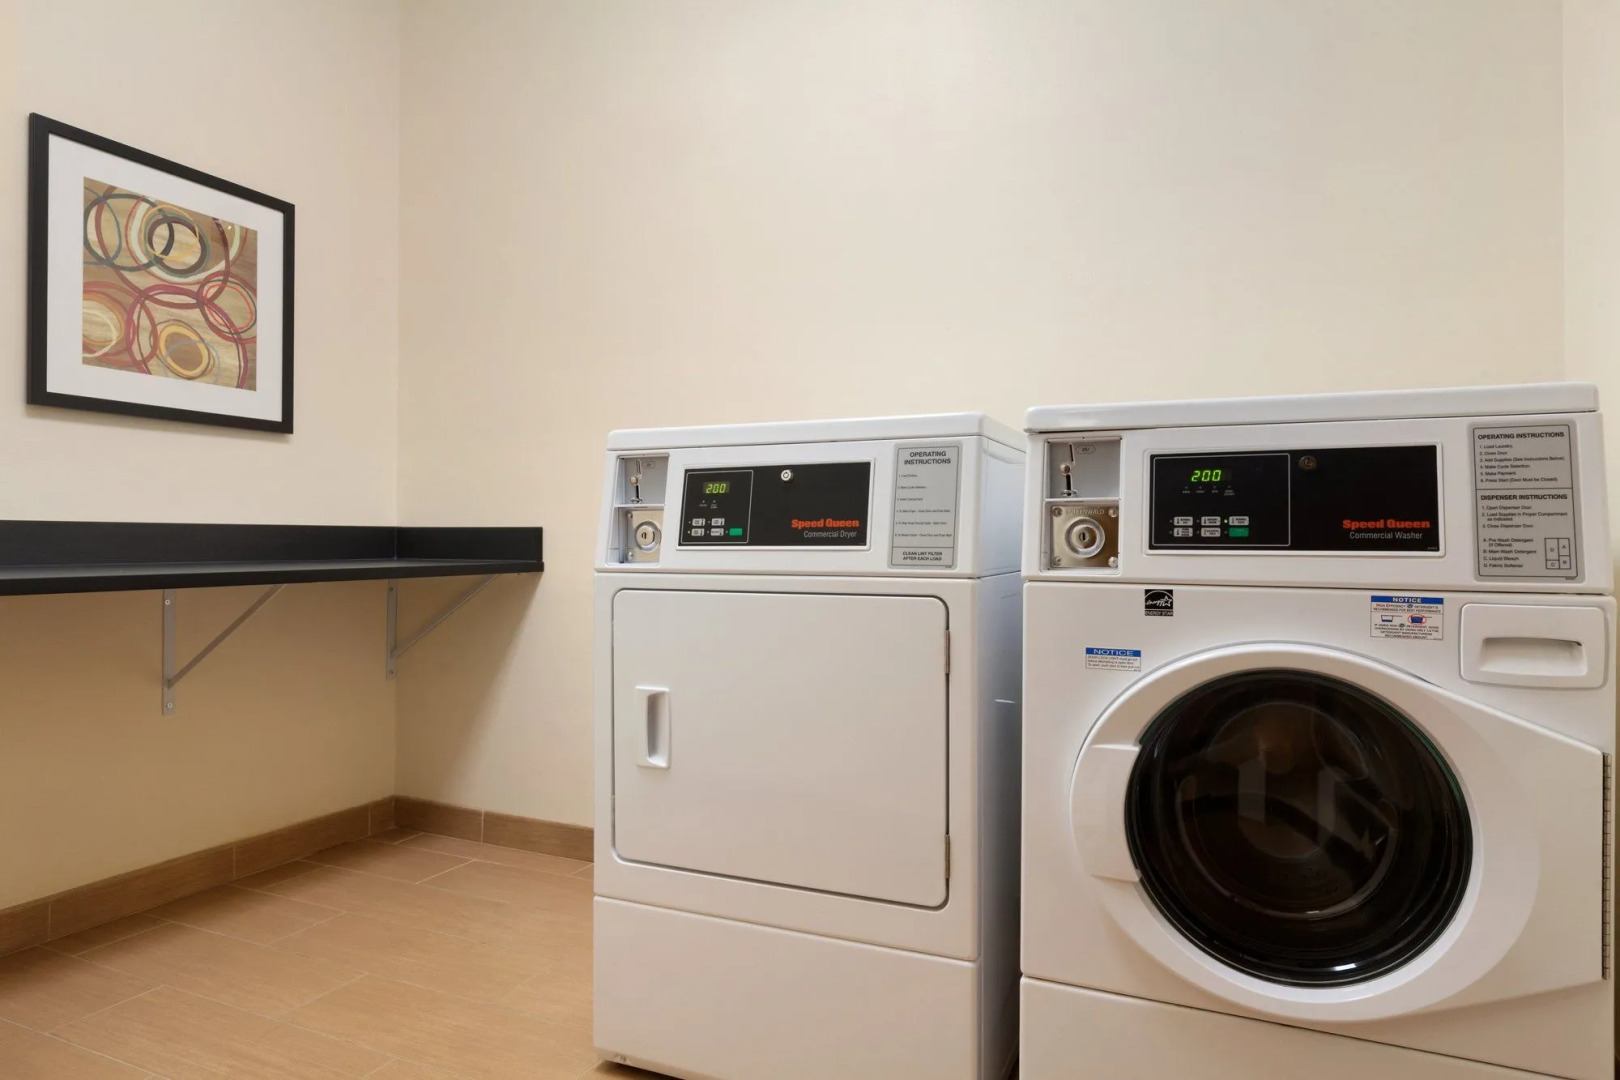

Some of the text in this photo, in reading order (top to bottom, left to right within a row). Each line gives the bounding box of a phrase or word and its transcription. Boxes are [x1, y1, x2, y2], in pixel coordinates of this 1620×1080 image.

[1191, 470, 1221, 482] 200
[706, 484, 726, 493] 200
[791, 518, 859, 529] Speed Queen
[1343, 519, 1430, 530] Speed Queen
